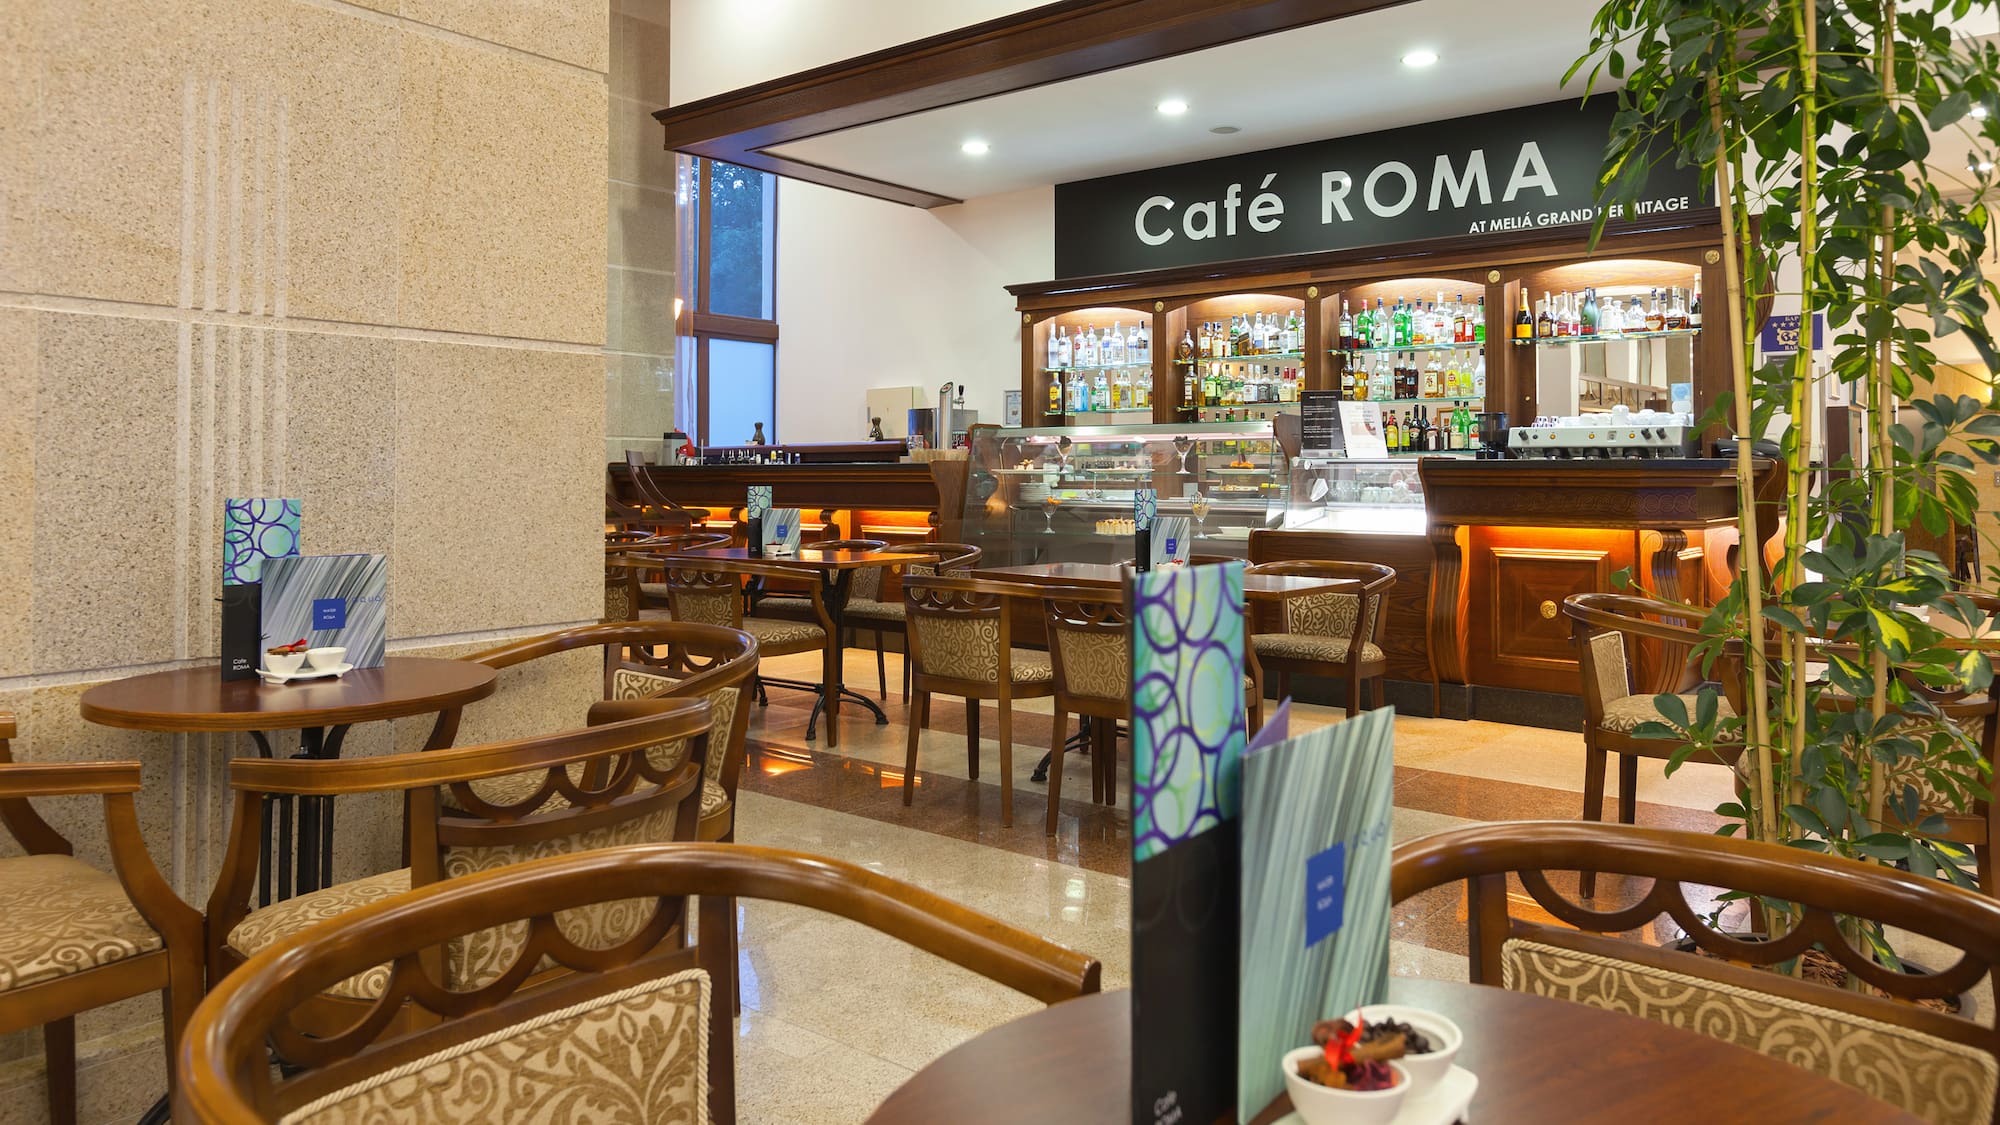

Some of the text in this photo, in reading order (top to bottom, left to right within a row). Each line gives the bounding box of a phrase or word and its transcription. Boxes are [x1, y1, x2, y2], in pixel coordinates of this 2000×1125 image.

[1135, 141, 1559, 245] Café ROMA
[1469, 221, 1486, 234] AT
[1490, 212, 1531, 232] MELIÁ
[1537, 208, 1593, 226] GRAND
